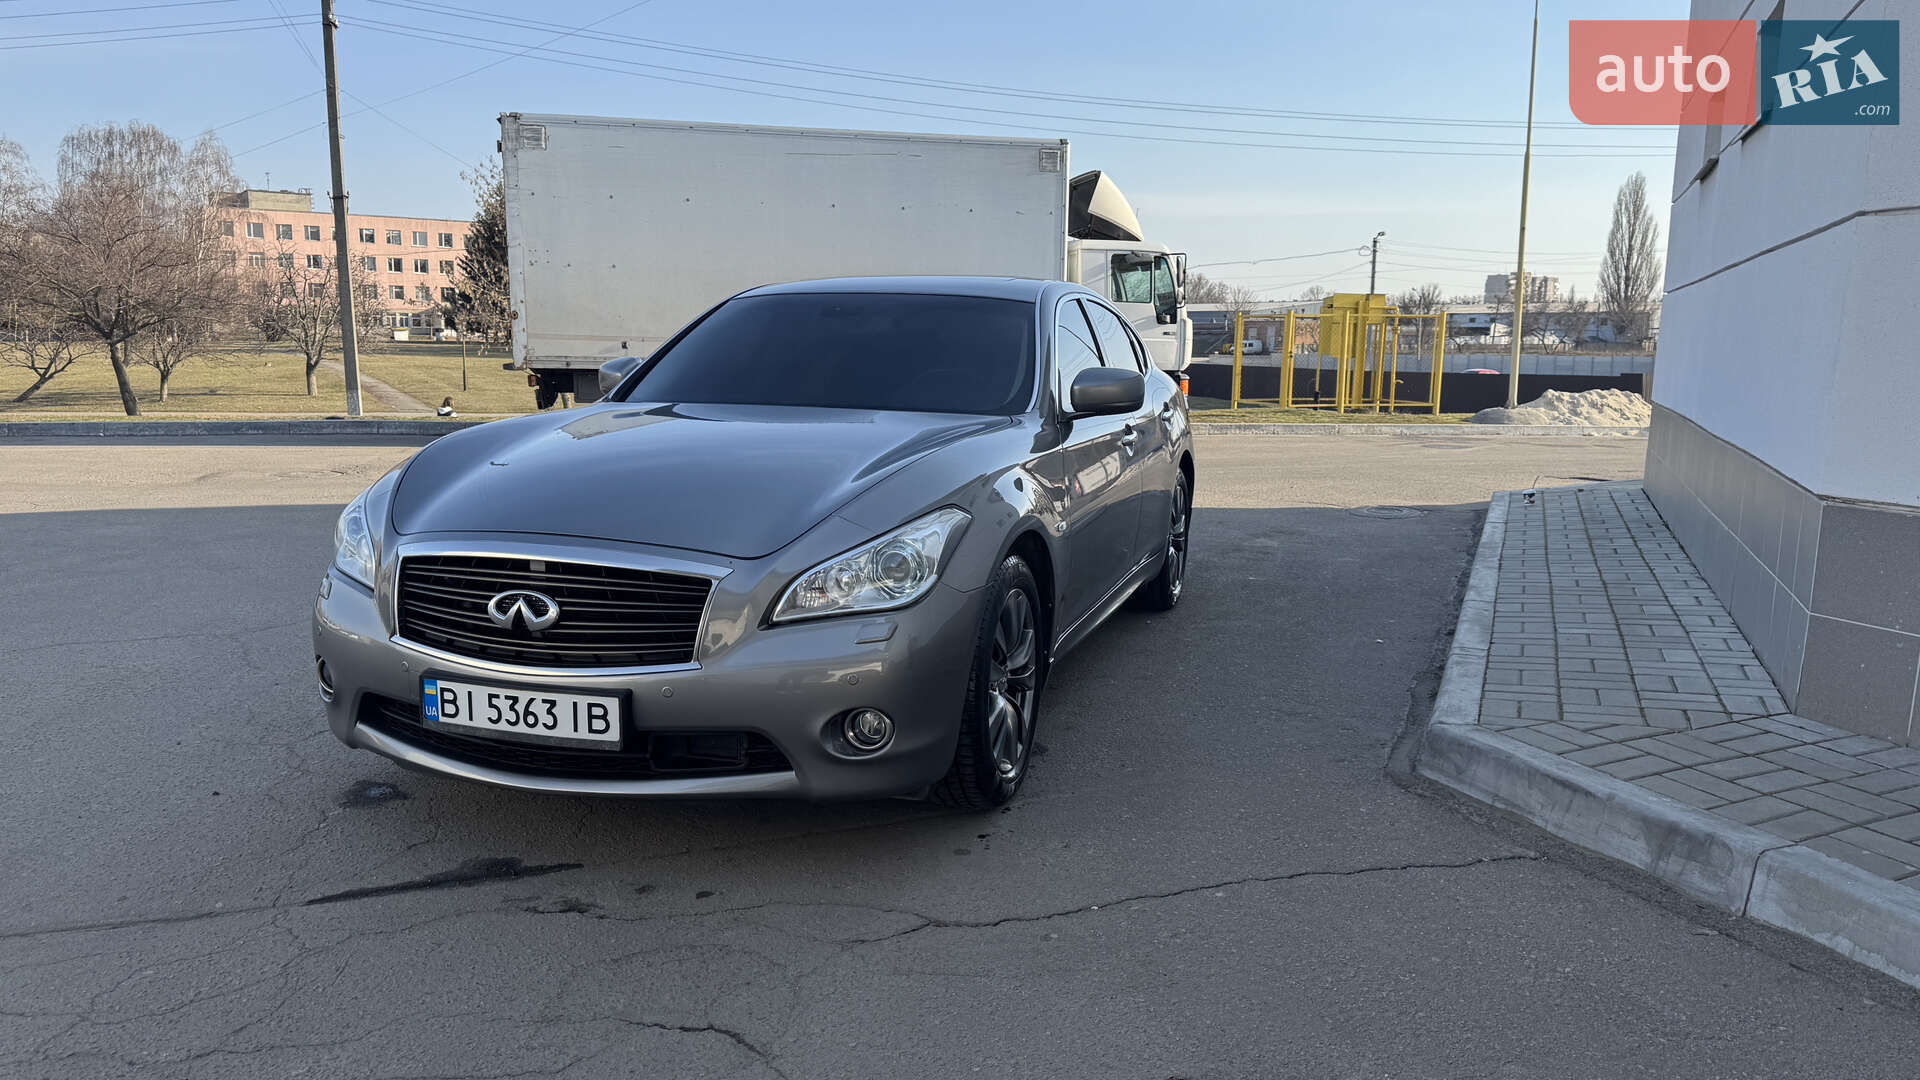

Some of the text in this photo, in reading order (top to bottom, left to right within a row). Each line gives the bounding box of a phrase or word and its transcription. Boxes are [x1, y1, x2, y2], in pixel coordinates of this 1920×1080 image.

[425, 706, 438, 717] UA
[439, 687, 610, 734] BI 5363 IB
